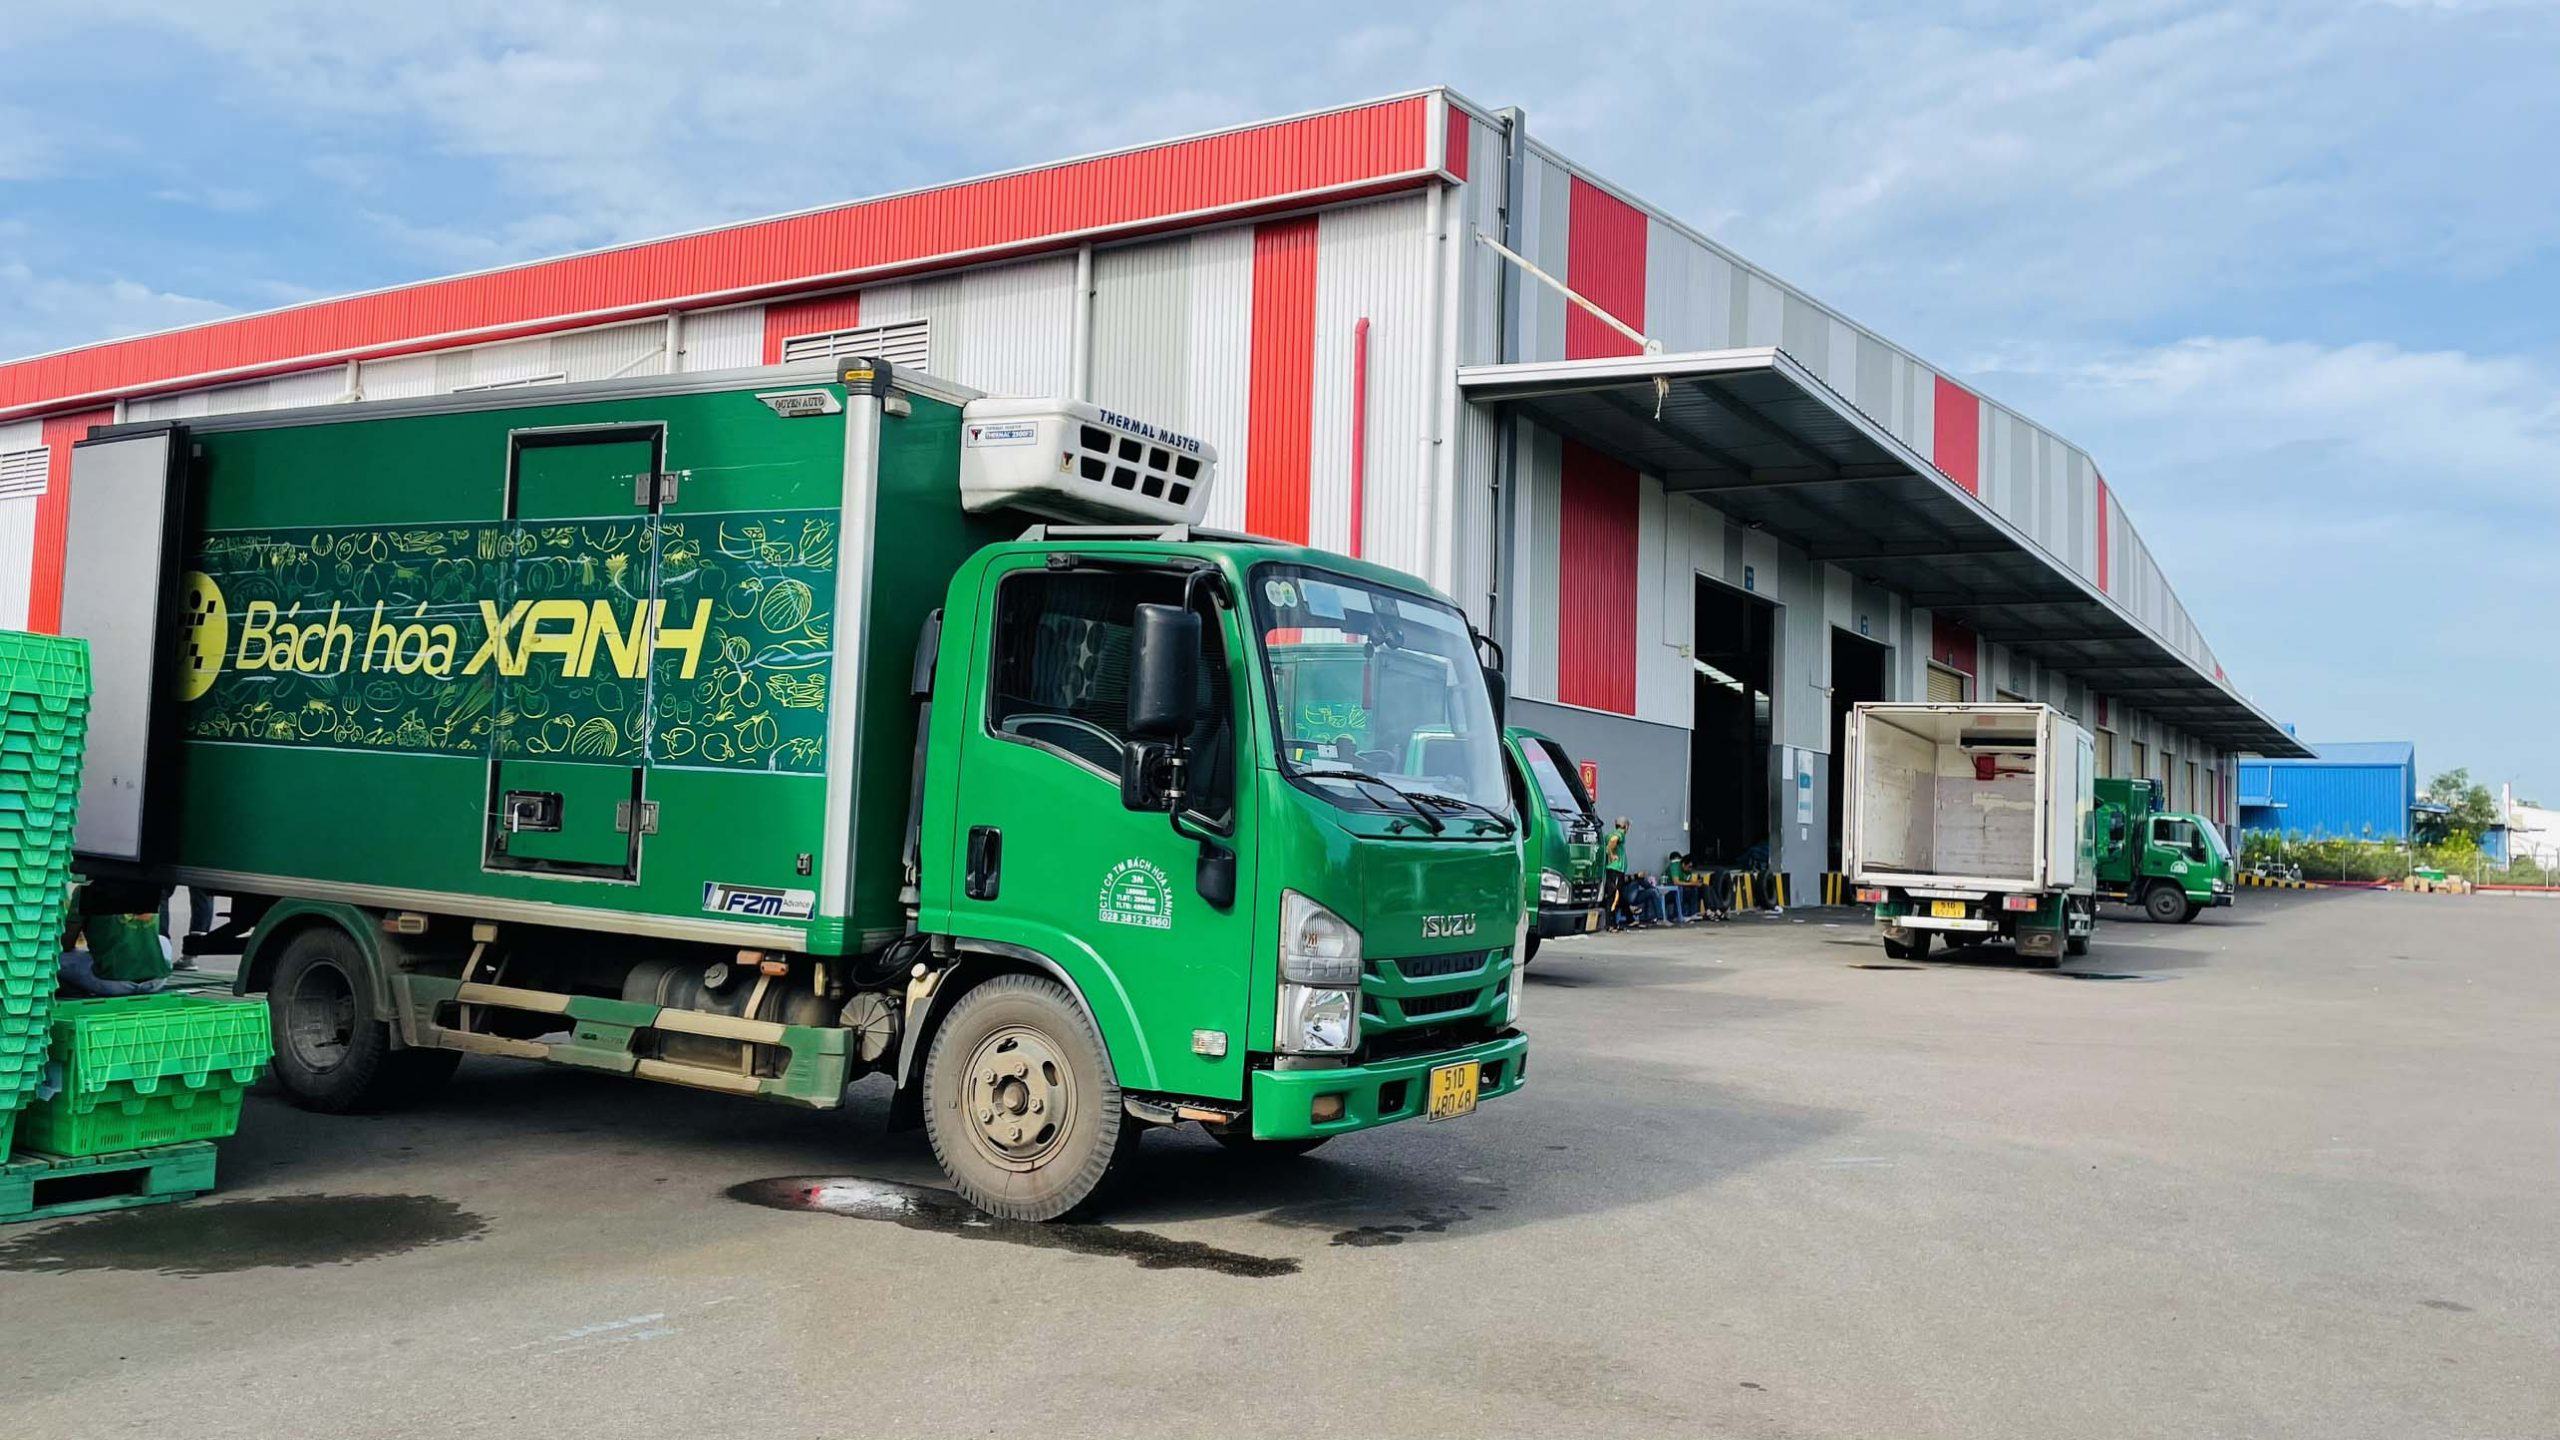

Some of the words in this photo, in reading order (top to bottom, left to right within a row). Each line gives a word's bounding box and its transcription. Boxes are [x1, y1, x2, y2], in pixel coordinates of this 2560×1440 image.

[1100, 409, 1155, 438] THERMAL
[1159, 429, 1200, 453] MASTER
[236, 599, 355, 673] Bách
[361, 599, 456, 677] hóa
[461, 598, 713, 680] XANH
[1112, 861, 1127, 875] TM
[1127, 856, 1152, 870] BÁCH
[1103, 873, 1114, 887] CP
[1151, 865, 1168, 886] HÓA
[1099, 888, 1109, 909] CTY
[1162, 887, 1173, 916] XANH
[1101, 911, 1119, 921] 028
[1421, 913, 1476, 939] ISUZU
[1445, 1067, 1465, 1091] 51D
